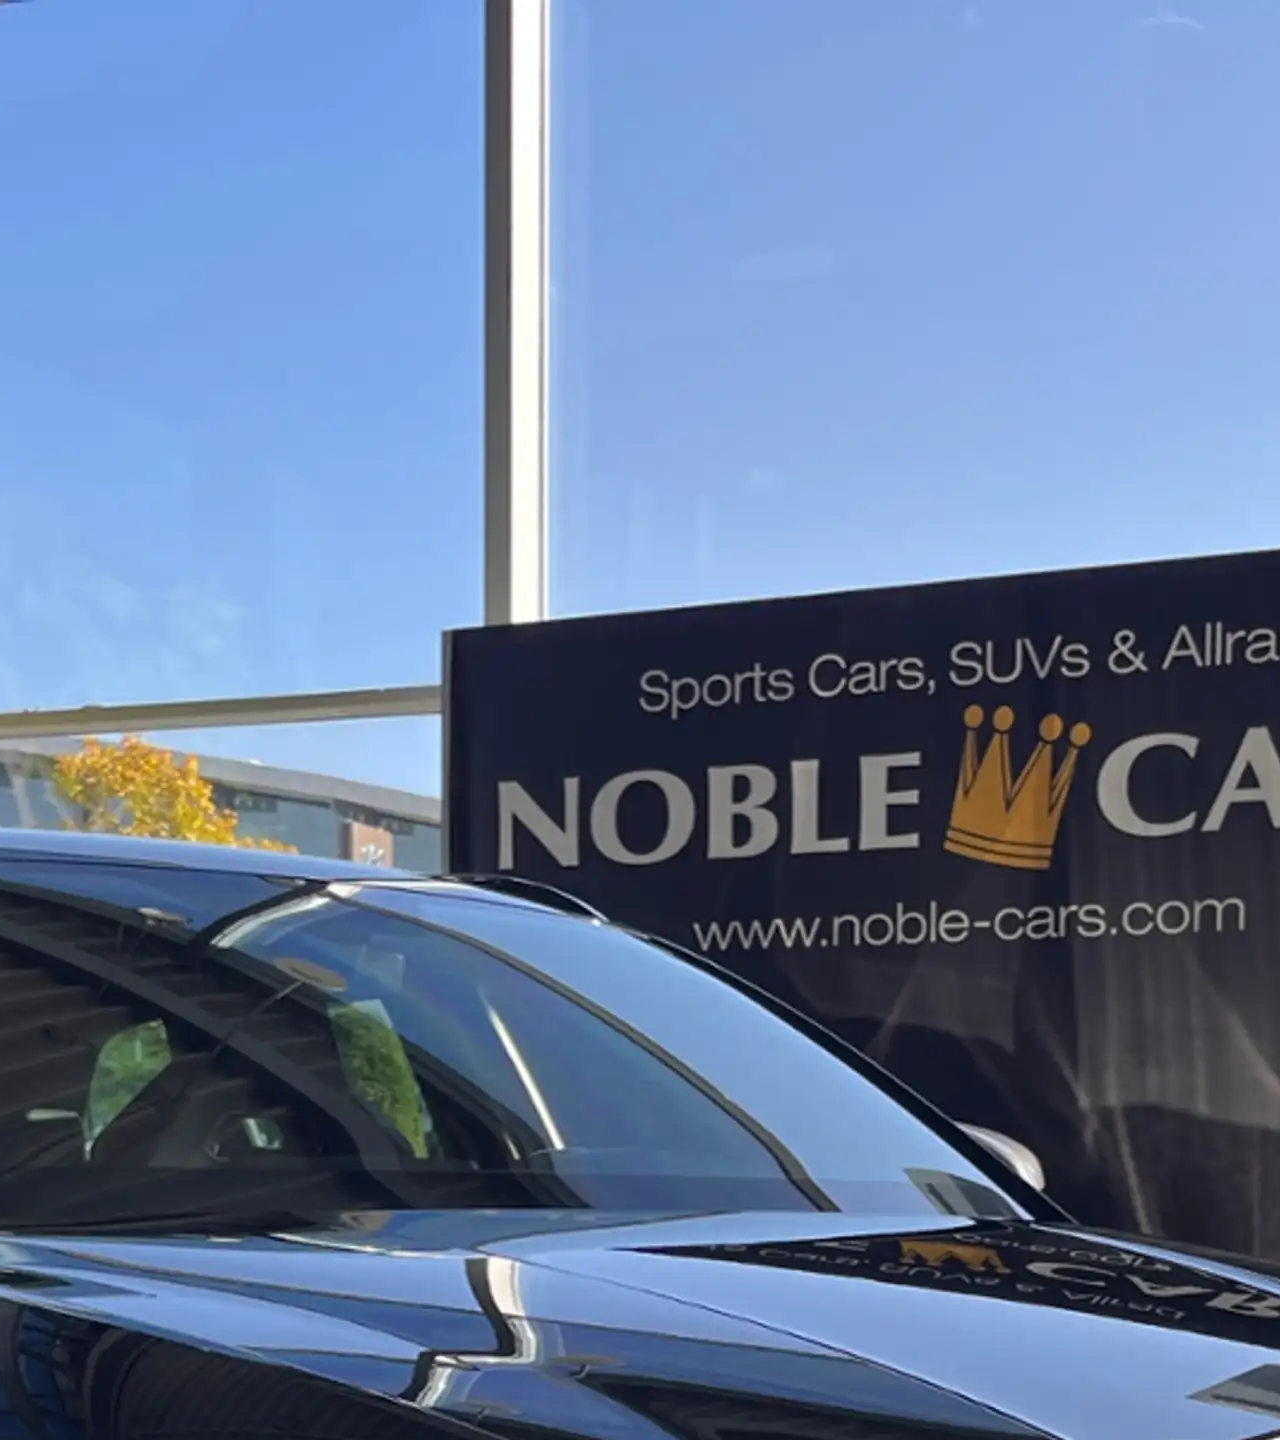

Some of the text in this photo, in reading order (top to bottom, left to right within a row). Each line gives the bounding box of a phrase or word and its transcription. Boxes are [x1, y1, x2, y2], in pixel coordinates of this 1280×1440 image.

[639, 669, 795, 720] Sports
[808, 654, 937, 697] Cars,
[949, 634, 1091, 686] SUVs
[1107, 629, 1148, 675] &
[497, 751, 921, 870] NOBLE
[693, 896, 1246, 952] www.noble-cars.com
